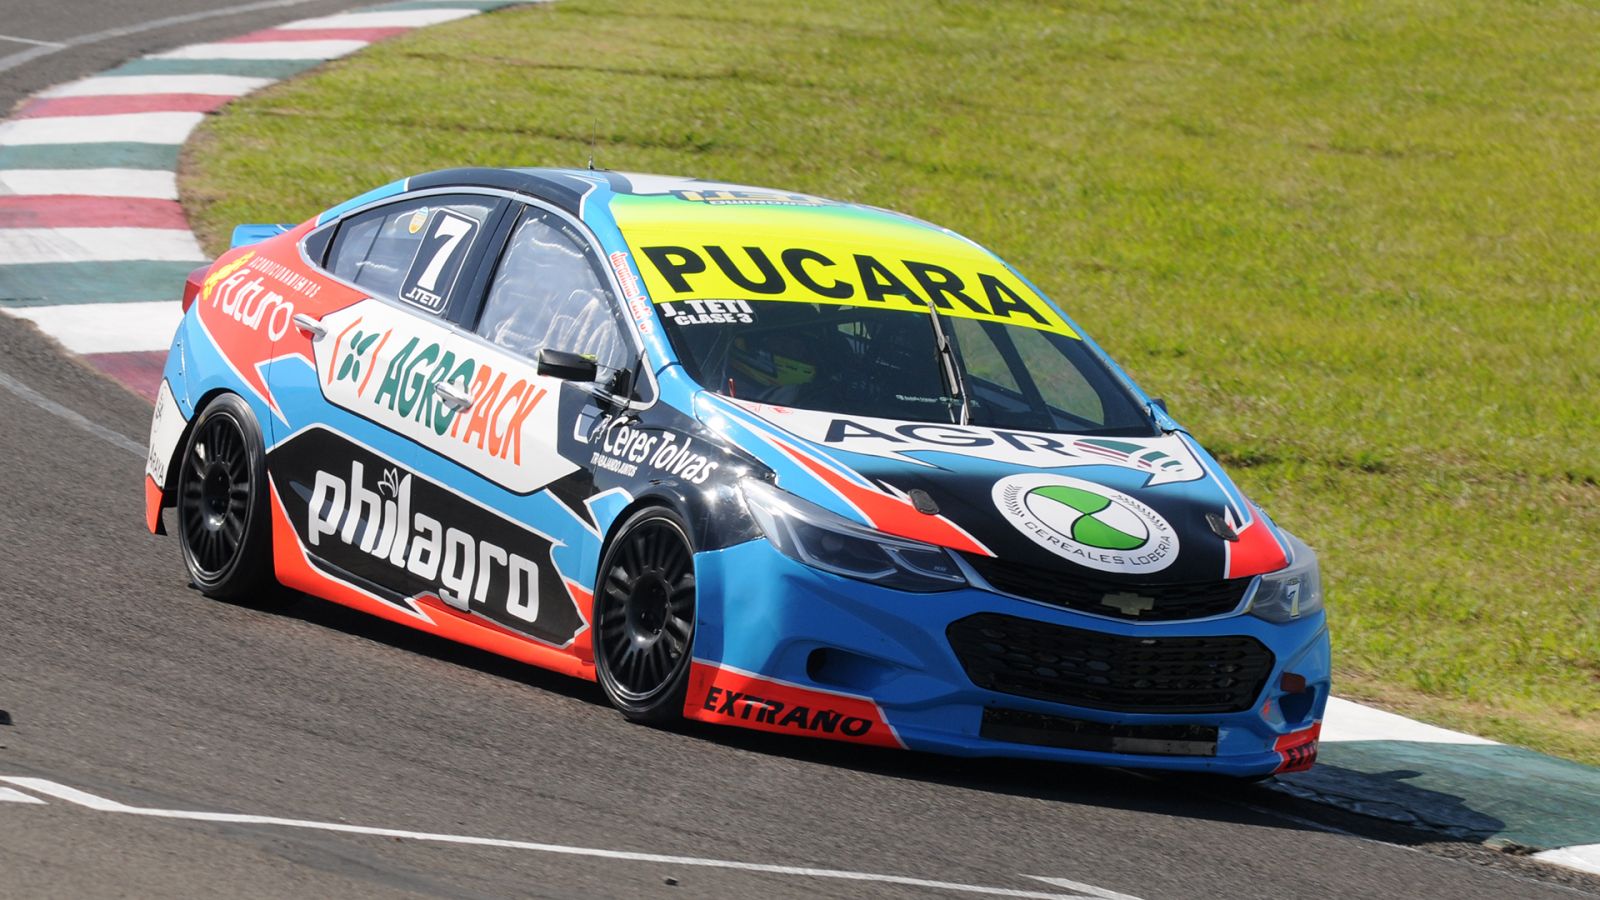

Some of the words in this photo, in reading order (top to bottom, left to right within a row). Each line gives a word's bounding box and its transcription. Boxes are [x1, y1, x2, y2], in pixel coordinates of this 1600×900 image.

[417, 215, 473, 291] 7
[640, 245, 1053, 326] PUCARA
[213, 268, 294, 342] Futuro
[674, 313, 737, 326] CLASE
[737, 313, 753, 324] 3
[684, 299, 754, 316] TETI
[603, 416, 658, 463] Ceres
[648, 431, 719, 485] Tolvas
[308, 460, 540, 623] philagro
[1024, 521, 1124, 565] CEREALES
